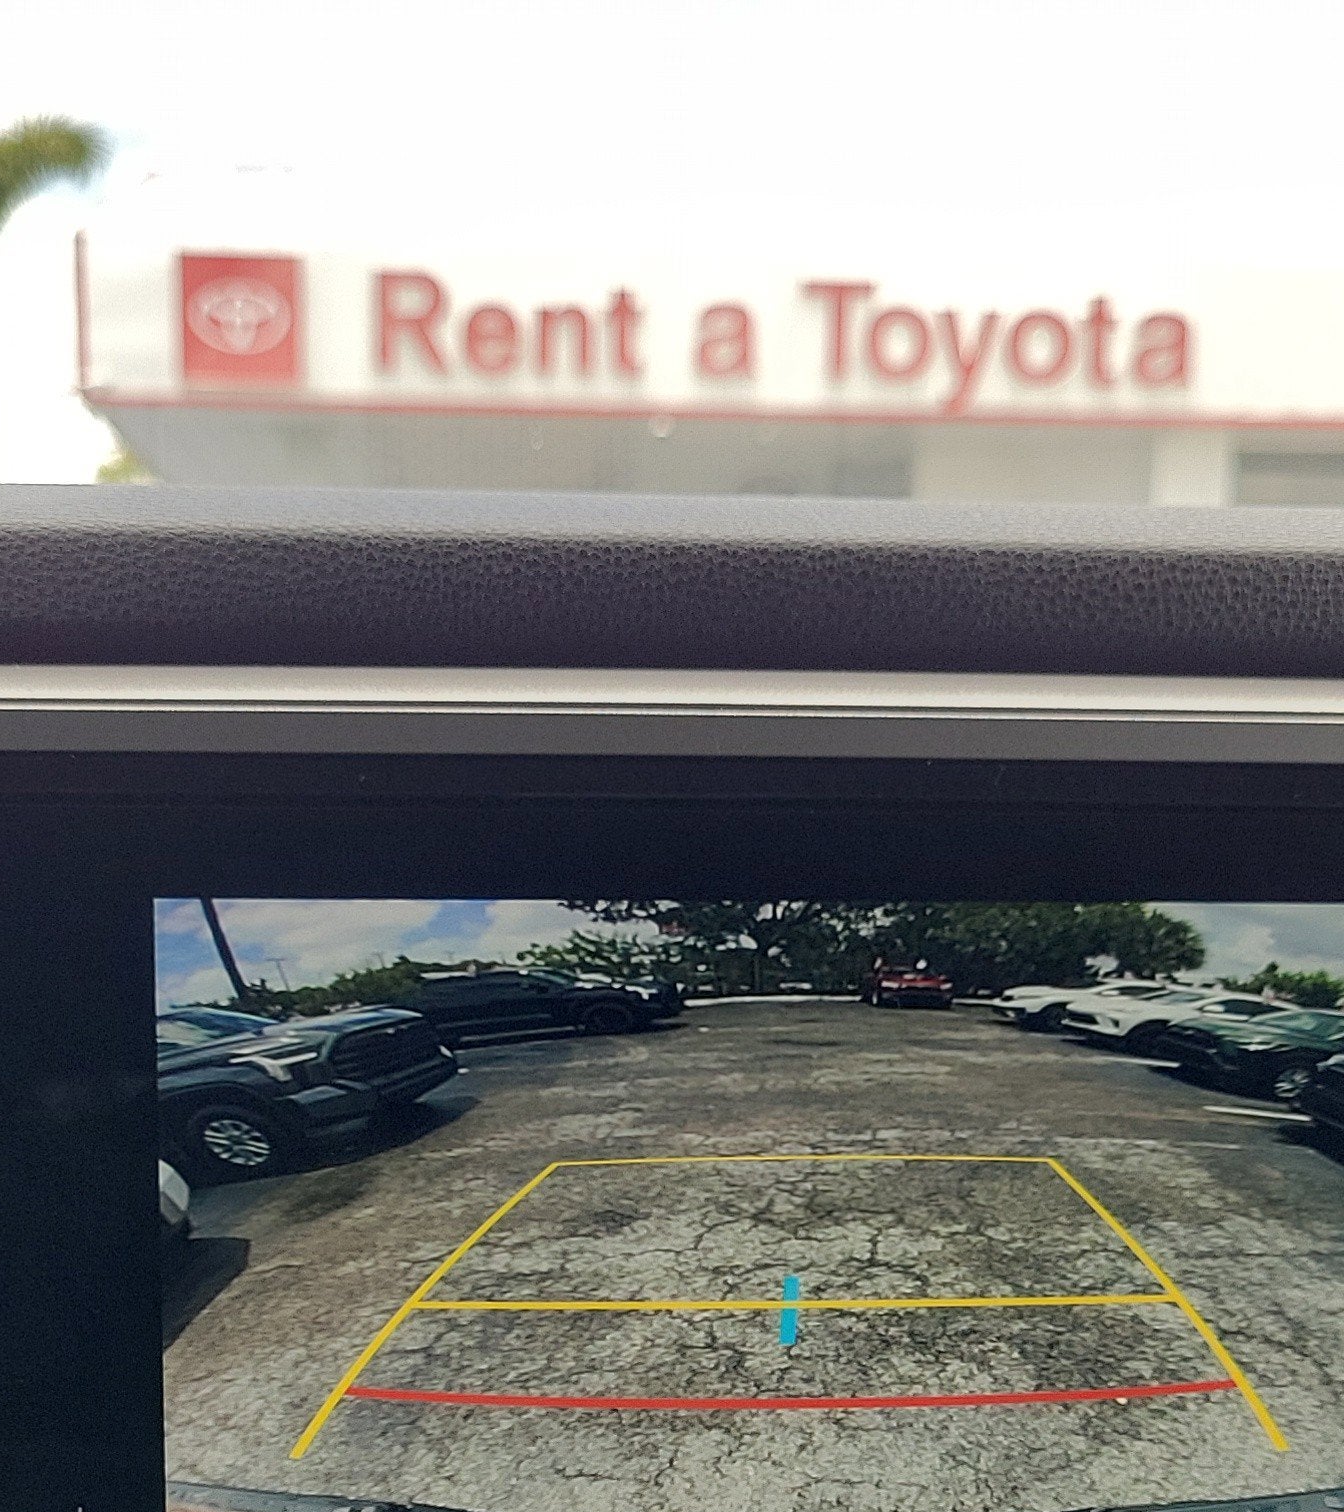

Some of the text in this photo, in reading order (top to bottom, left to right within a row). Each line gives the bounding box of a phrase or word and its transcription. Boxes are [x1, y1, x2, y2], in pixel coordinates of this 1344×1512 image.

[373, 269, 1191, 415] Rent a Toyota
